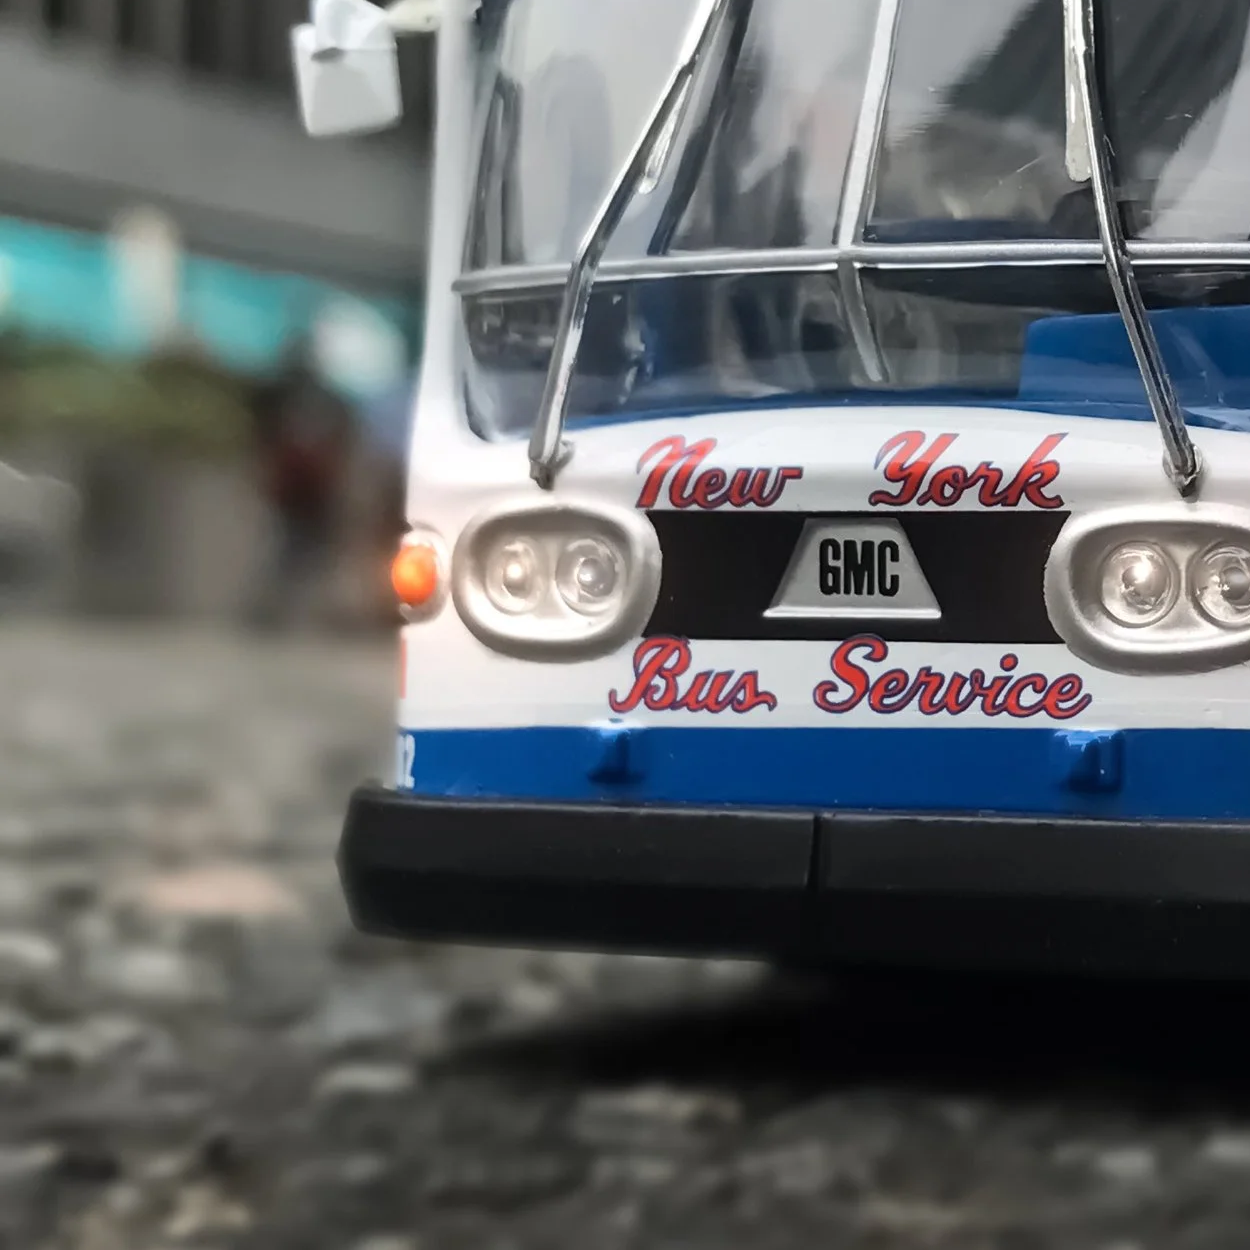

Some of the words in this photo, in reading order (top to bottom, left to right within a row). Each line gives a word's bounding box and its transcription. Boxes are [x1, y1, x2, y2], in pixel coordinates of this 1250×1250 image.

[635, 433, 804, 510] New
[868, 429, 1070, 509] York
[818, 537, 900, 597] GMC
[608, 636, 778, 715] Bus
[813, 633, 1093, 720] Service
